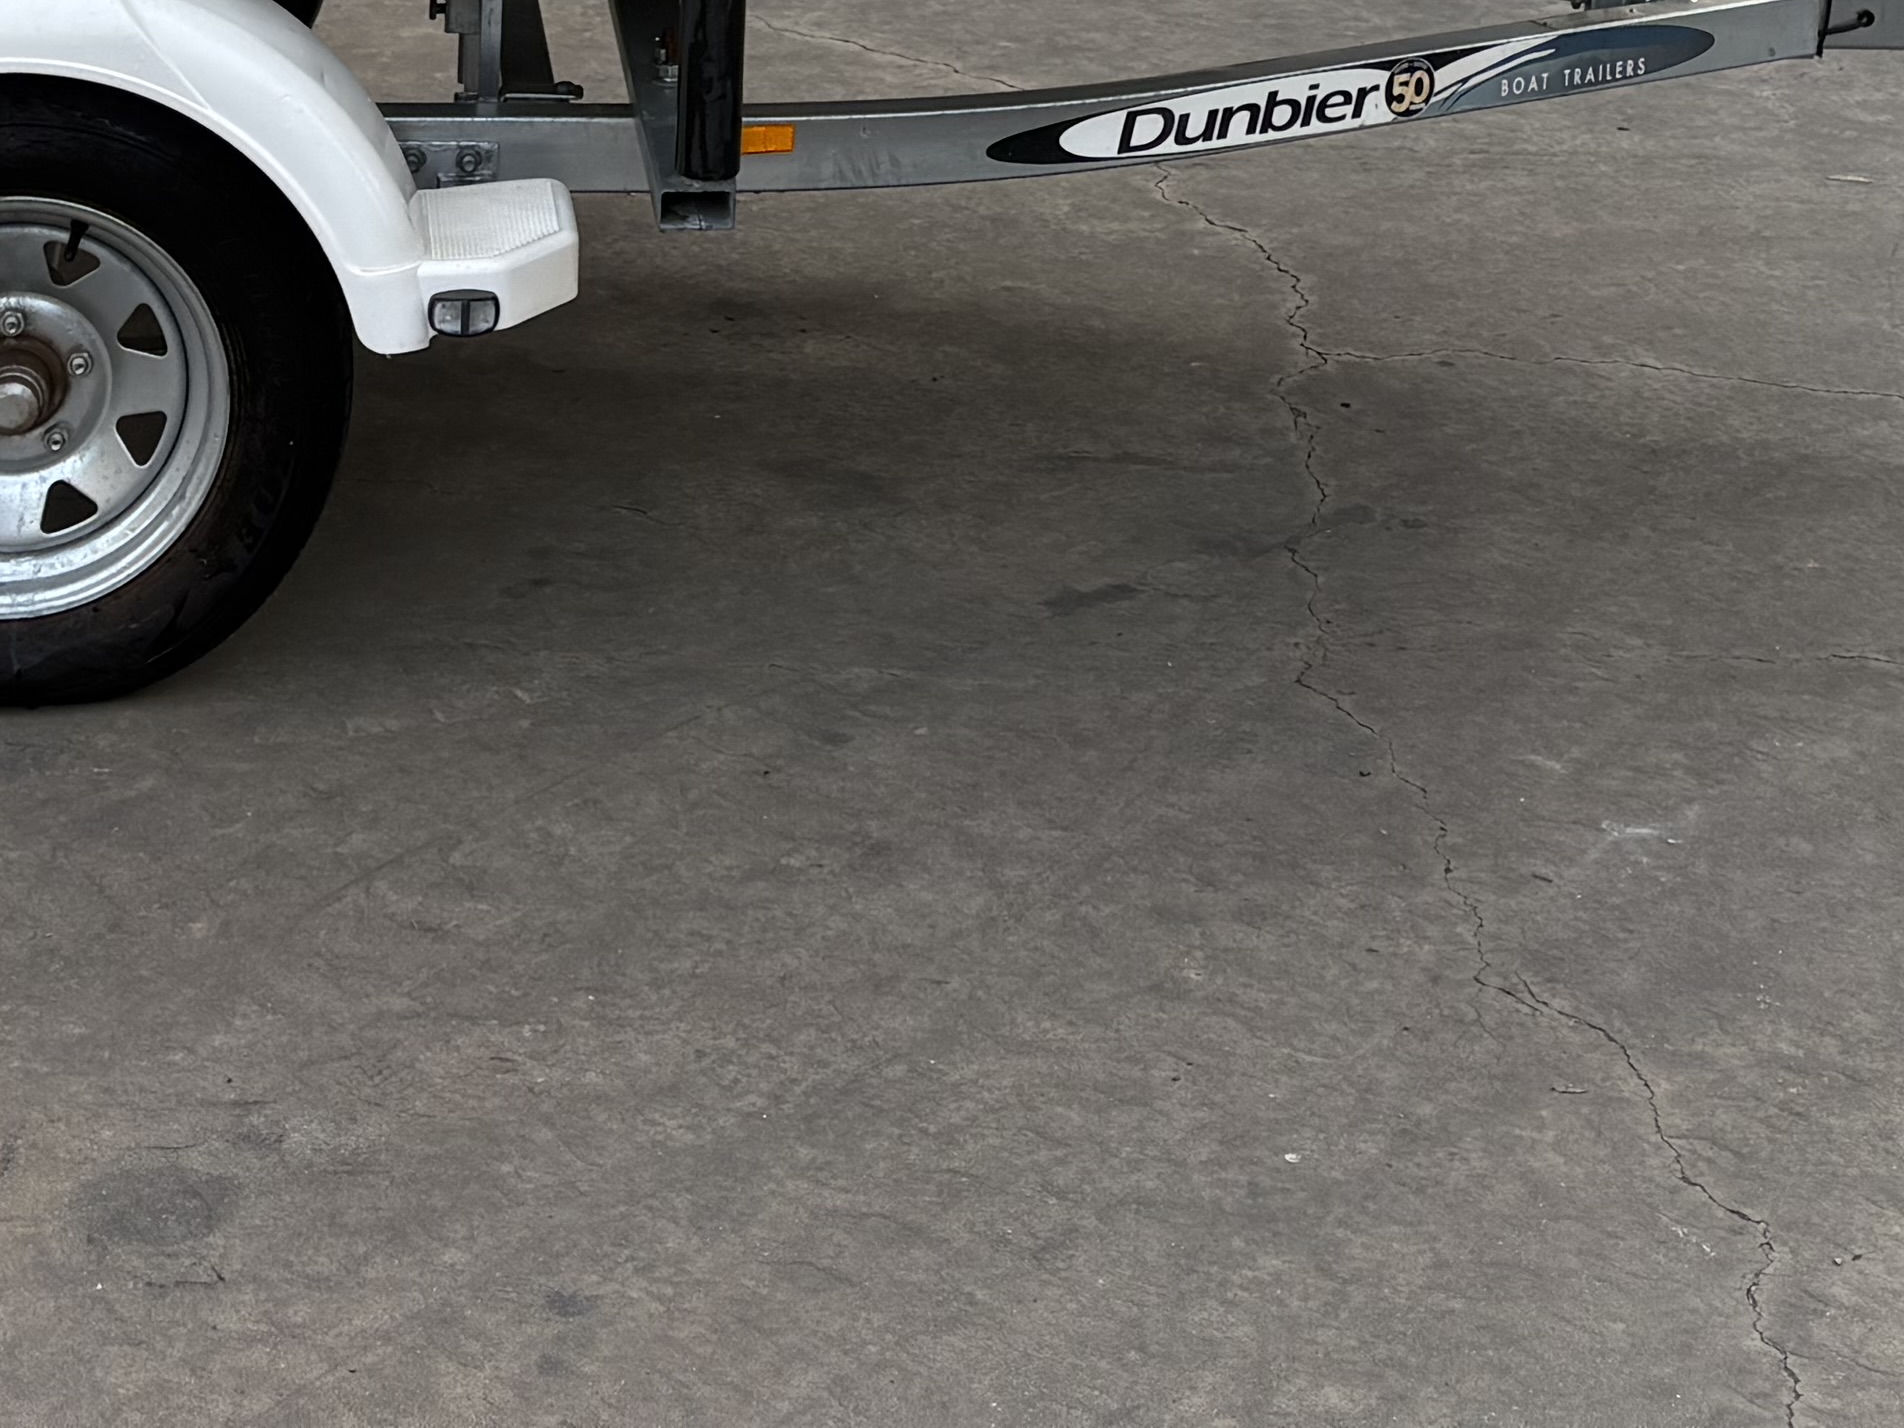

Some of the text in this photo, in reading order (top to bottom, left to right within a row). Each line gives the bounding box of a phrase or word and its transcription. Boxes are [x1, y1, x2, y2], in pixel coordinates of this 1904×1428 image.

[1117, 57, 1646, 155] Dunbier 50 BOAT TRAILERS
